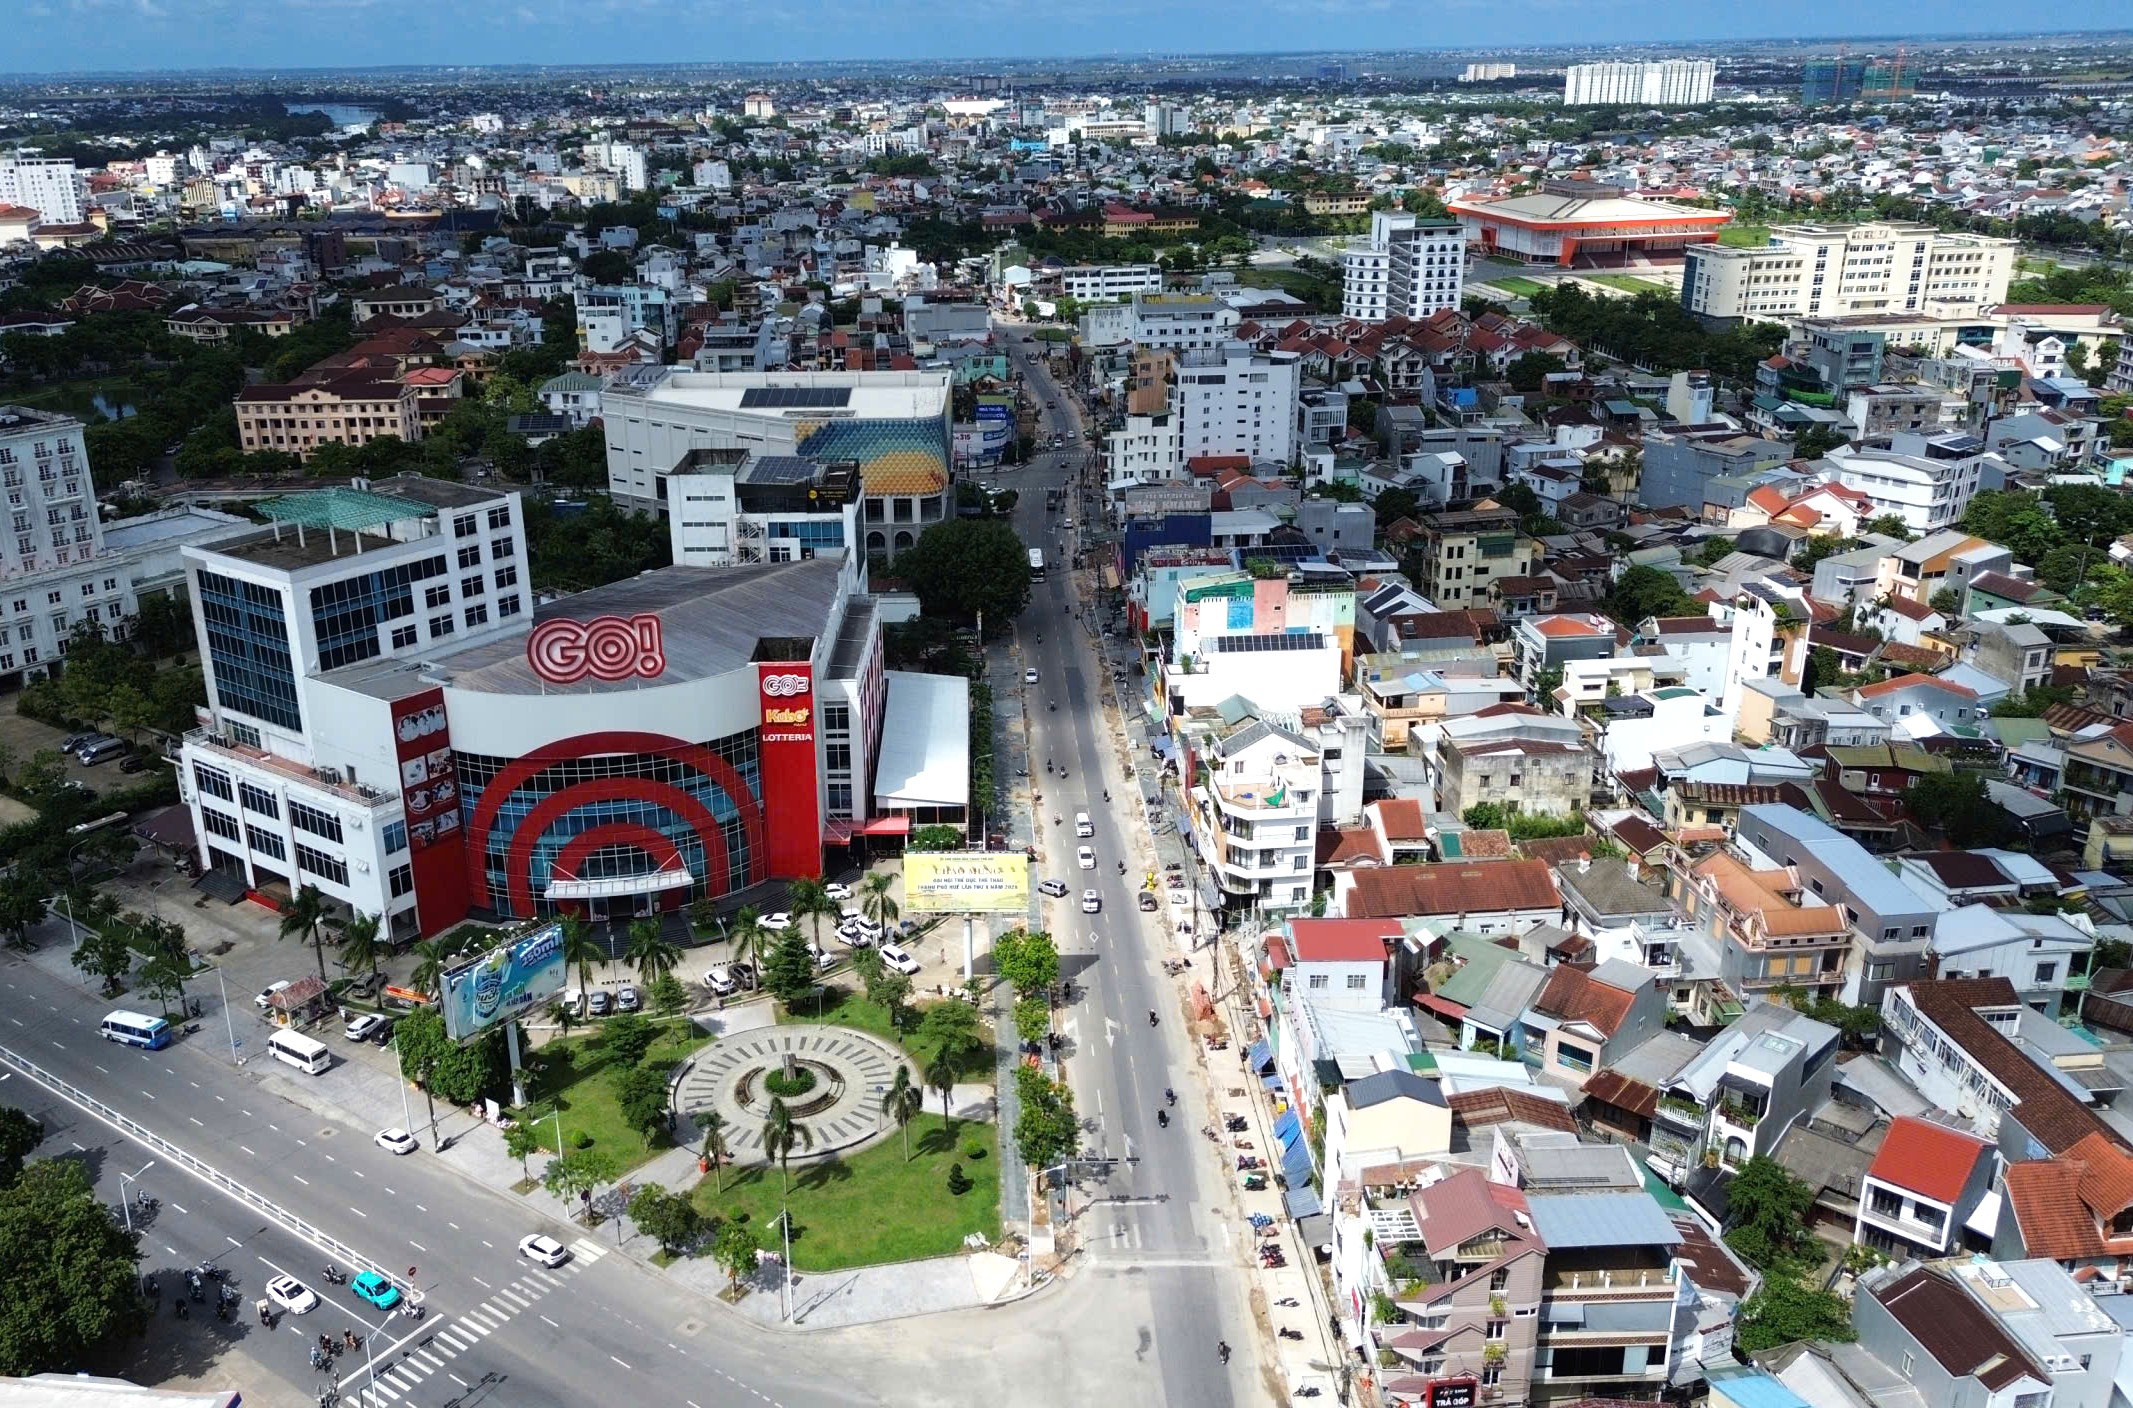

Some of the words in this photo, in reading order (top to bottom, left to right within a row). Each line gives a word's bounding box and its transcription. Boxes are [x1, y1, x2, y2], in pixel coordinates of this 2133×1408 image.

[527, 613, 665, 684] GO!
[762, 733, 813, 742] LOTTERIA
[1436, 1396, 1452, 1407] TRẢ
